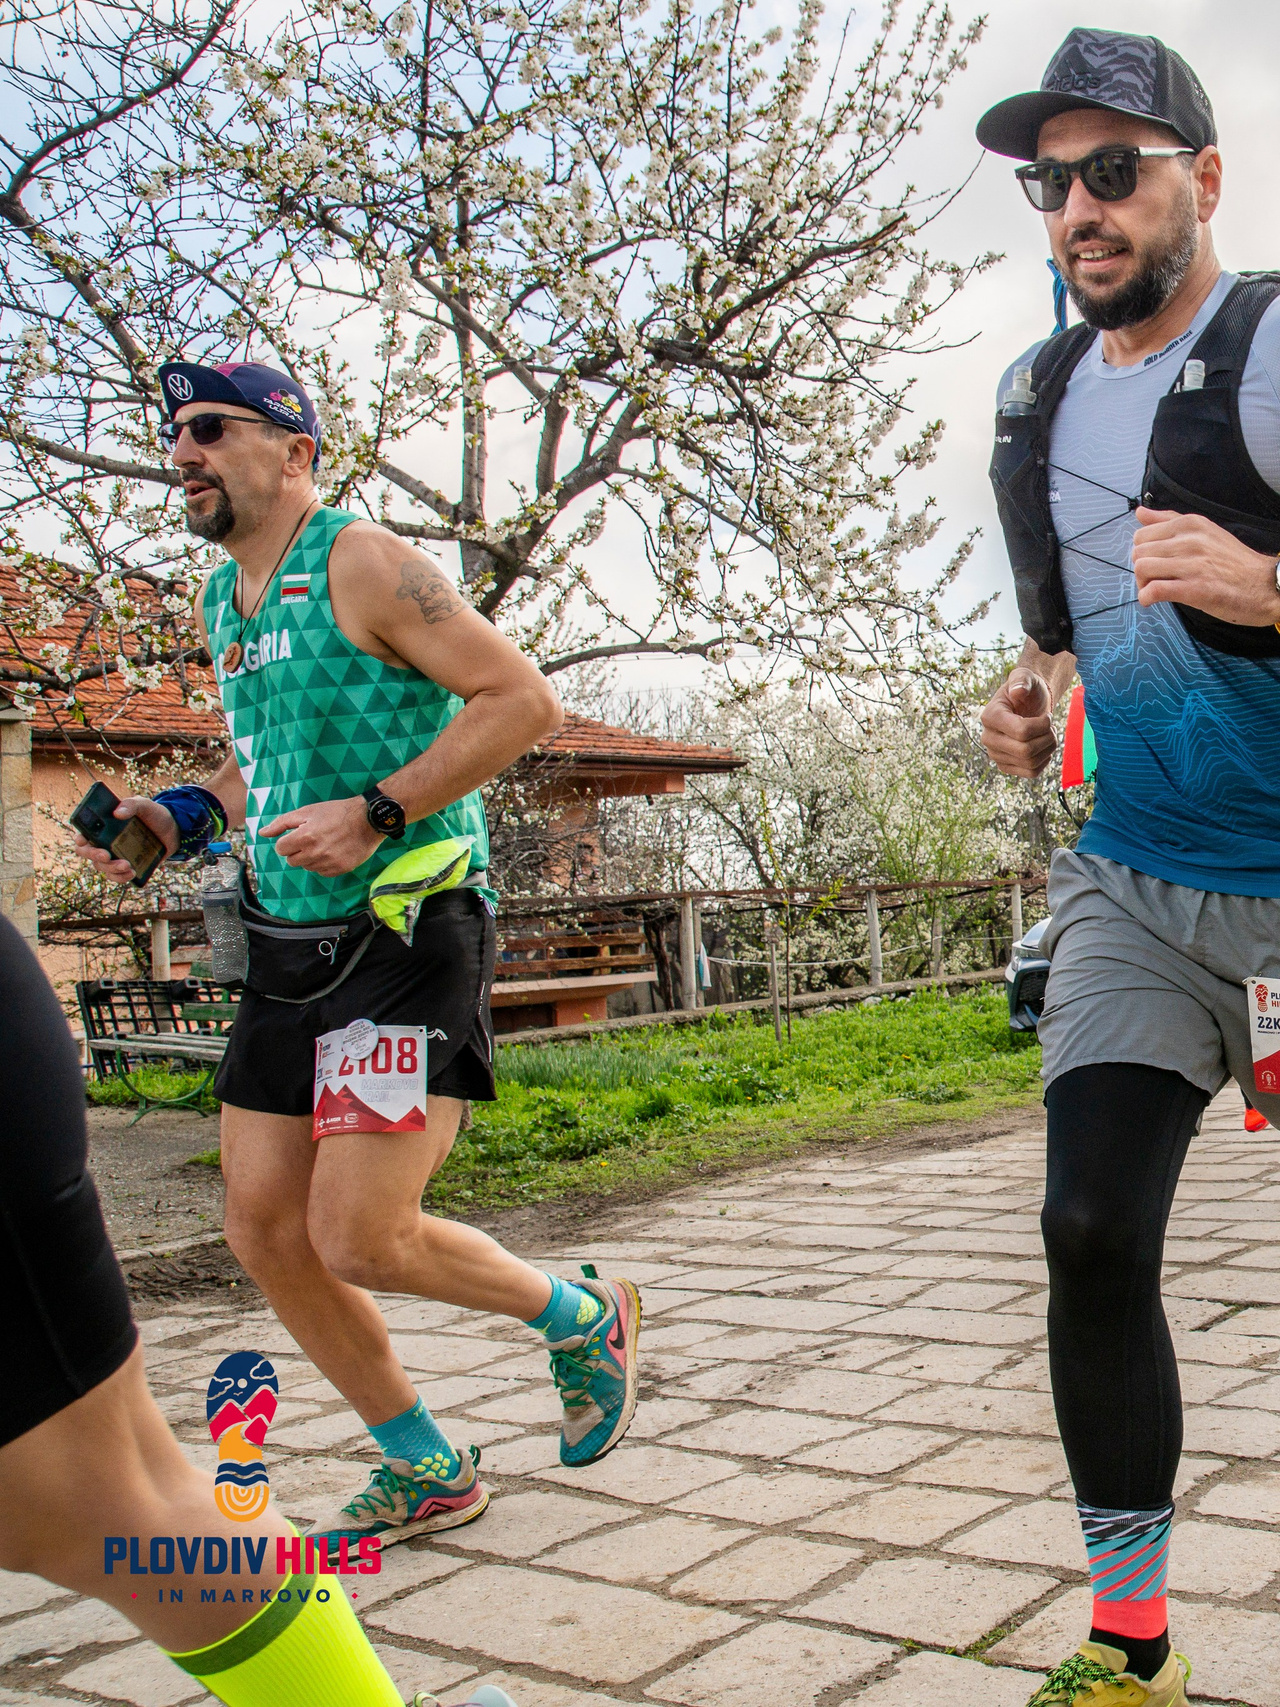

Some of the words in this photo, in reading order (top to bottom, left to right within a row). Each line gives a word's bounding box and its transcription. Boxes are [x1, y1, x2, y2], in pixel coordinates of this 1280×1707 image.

[263, 397, 304, 421] TARNOVO
[269, 404, 296, 421] ULTRA
[218, 628, 292, 682] BGARIA
[360, 1079, 419, 1091] MARKOVO
